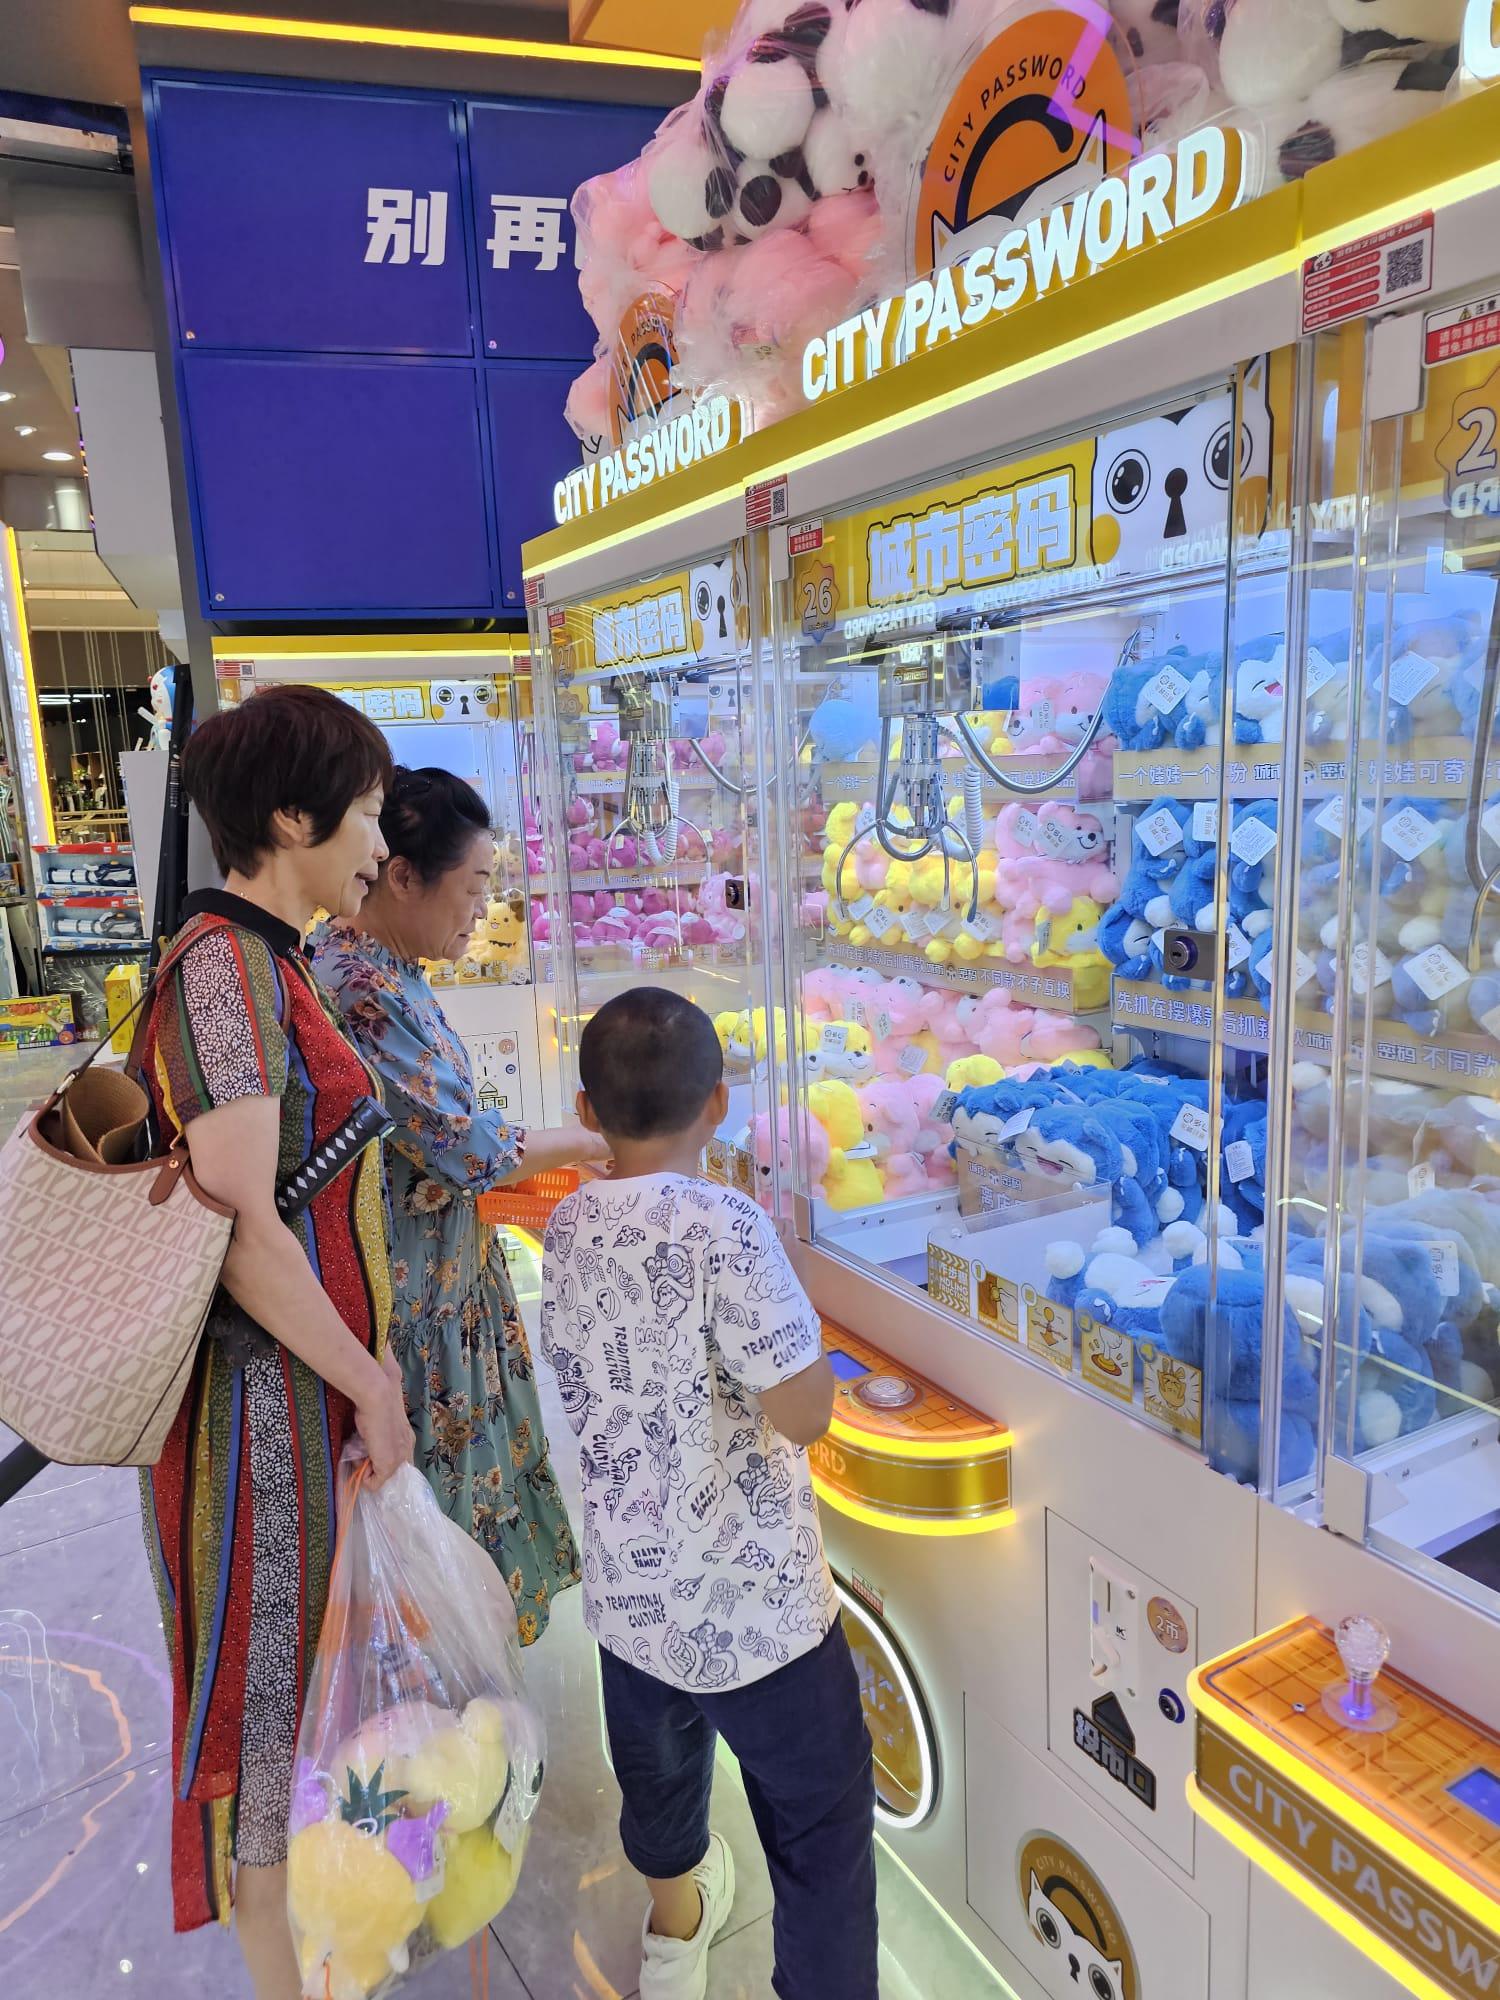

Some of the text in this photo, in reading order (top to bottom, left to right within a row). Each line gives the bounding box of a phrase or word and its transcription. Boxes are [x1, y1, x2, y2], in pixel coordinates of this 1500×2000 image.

[944, 53, 1087, 183] CITY PASSWORD
[363, 187, 582, 271] 别再
[802, 126, 1226, 400] CITY PASSWORD
[553, 464, 597, 526] CITY
[600, 395, 731, 508] PASSWORD
[869, 472, 1071, 602] 城市密码
[803, 577, 832, 618] 26
[1422, 1044, 1497, 1080] 不同款
[602, 1341, 622, 1391] CULTURE
[605, 1592, 666, 1612] TRADITIONAL
[628, 1605, 667, 1629] CULTURE
[1074, 1708, 1156, 1811] 投币口
[1036, 1855, 1118, 1944] CITY PASSWORD
[1229, 1764, 1500, 1992] CITY PASSW
